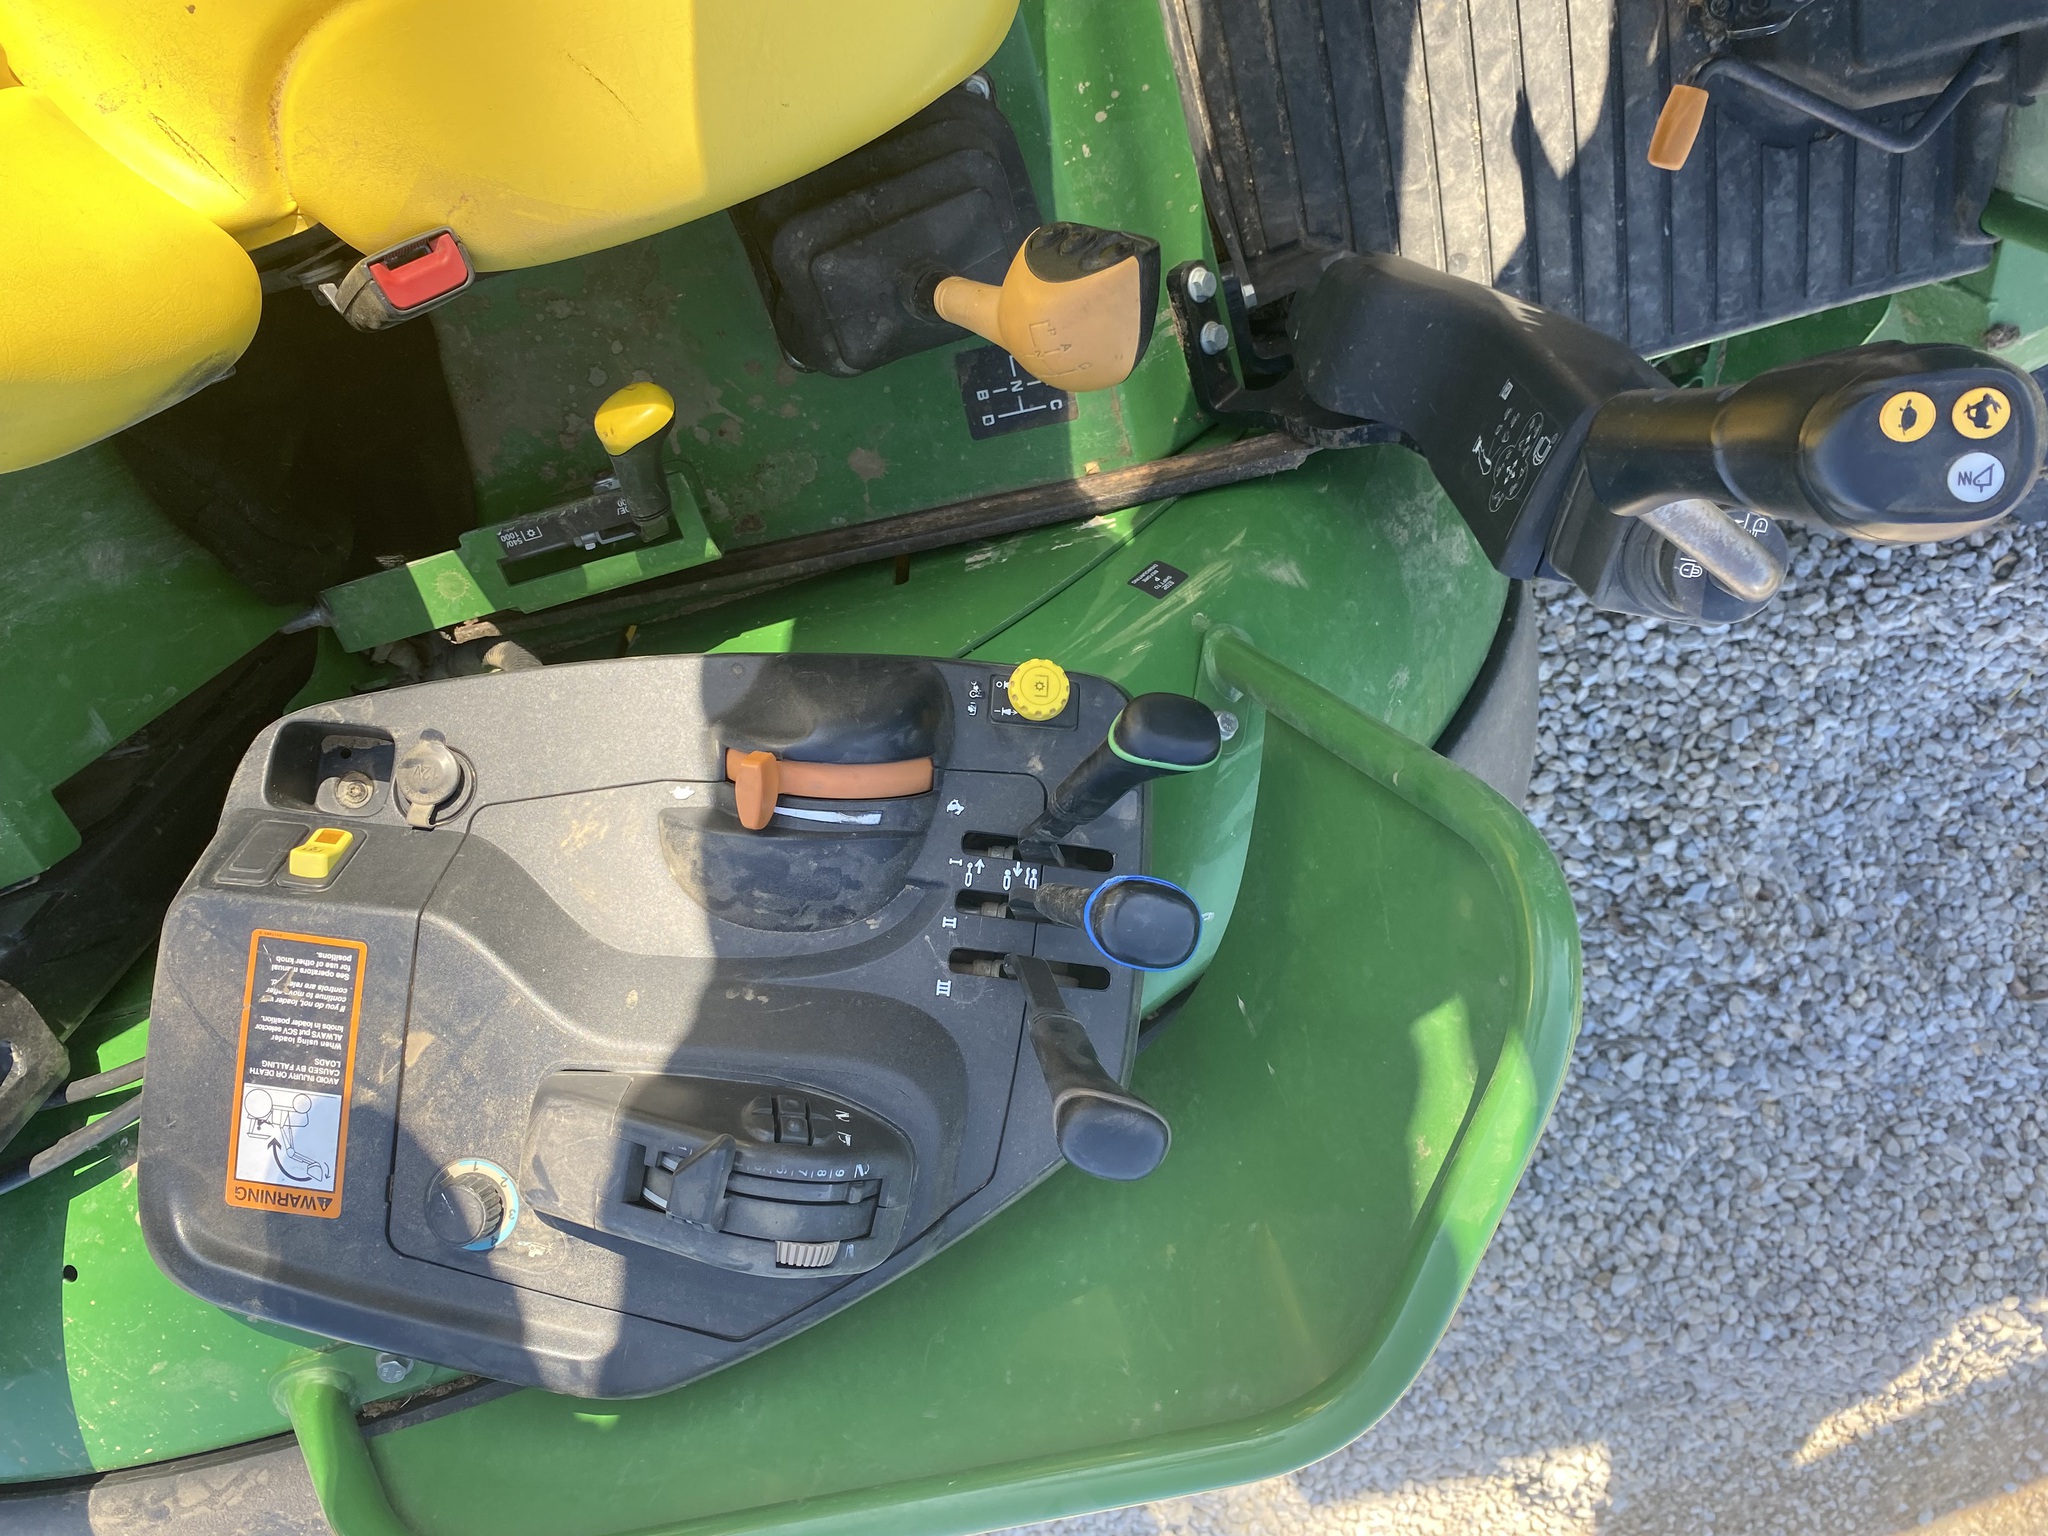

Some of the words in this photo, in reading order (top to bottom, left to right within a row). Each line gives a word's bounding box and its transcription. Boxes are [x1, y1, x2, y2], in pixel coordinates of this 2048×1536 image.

[1010, 380, 1023, 392] N
[976, 390, 990, 401] B
[1050, 399, 1063, 410] C
[982, 414, 995, 426] D
[500, 531, 519, 542] 1000
[506, 537, 523, 548] 540/
[413, 765, 439, 781] 12V
[275, 955, 295, 964] knob
[316, 952, 352, 962] positions.
[294, 957, 315, 968] other
[315, 960, 324, 968] of
[326, 962, 340, 970] use
[340, 963, 351, 972] for
[299, 967, 334, 978] operators
[335, 973, 350, 981] See
[270, 978, 302, 988] reled.
[935, 979, 952, 997] III
[317, 983, 348, 994] controls
[274, 997, 298, 1007] loader
[315, 992, 347, 1003] continue
[299, 999, 313, 1008] not,
[314, 1001, 324, 1009] do
[325, 1002, 340, 1011] you
[339, 1005, 346, 1013] If
[261, 1015, 291, 1025] position.
[291, 1019, 313, 1029] loader
[254, 1023, 282, 1033] selector
[282, 1027, 298, 1035] SCV
[313, 1022, 321, 1030] in
[321, 1023, 344, 1033] knobs
[299, 1028, 310, 1036] put
[311, 1031, 343, 1041] ALWAYS
[270, 1034, 295, 1044] loader
[297, 1037, 319, 1046] using
[319, 1041, 342, 1050] When
[261, 1060, 294, 1071] FALLING
[314, 1058, 341, 1067] LOADS
[249, 1067, 275, 1076] DEATH
[276, 1070, 287, 1078] OR
[288, 1071, 316, 1081] INJURY
[308, 1066, 340, 1077] CAUSED
[316, 1074, 340, 1085] AVOID
[473, 1161, 479, 1172] 1
[817, 1169, 827, 1177] 8
[835, 1169, 845, 1177] 9
[500, 1176, 509, 1188] 2
[234, 1186, 317, 1210] WARNING
[508, 1209, 517, 1220] 3
[490, 1235, 499, 1246] 4
